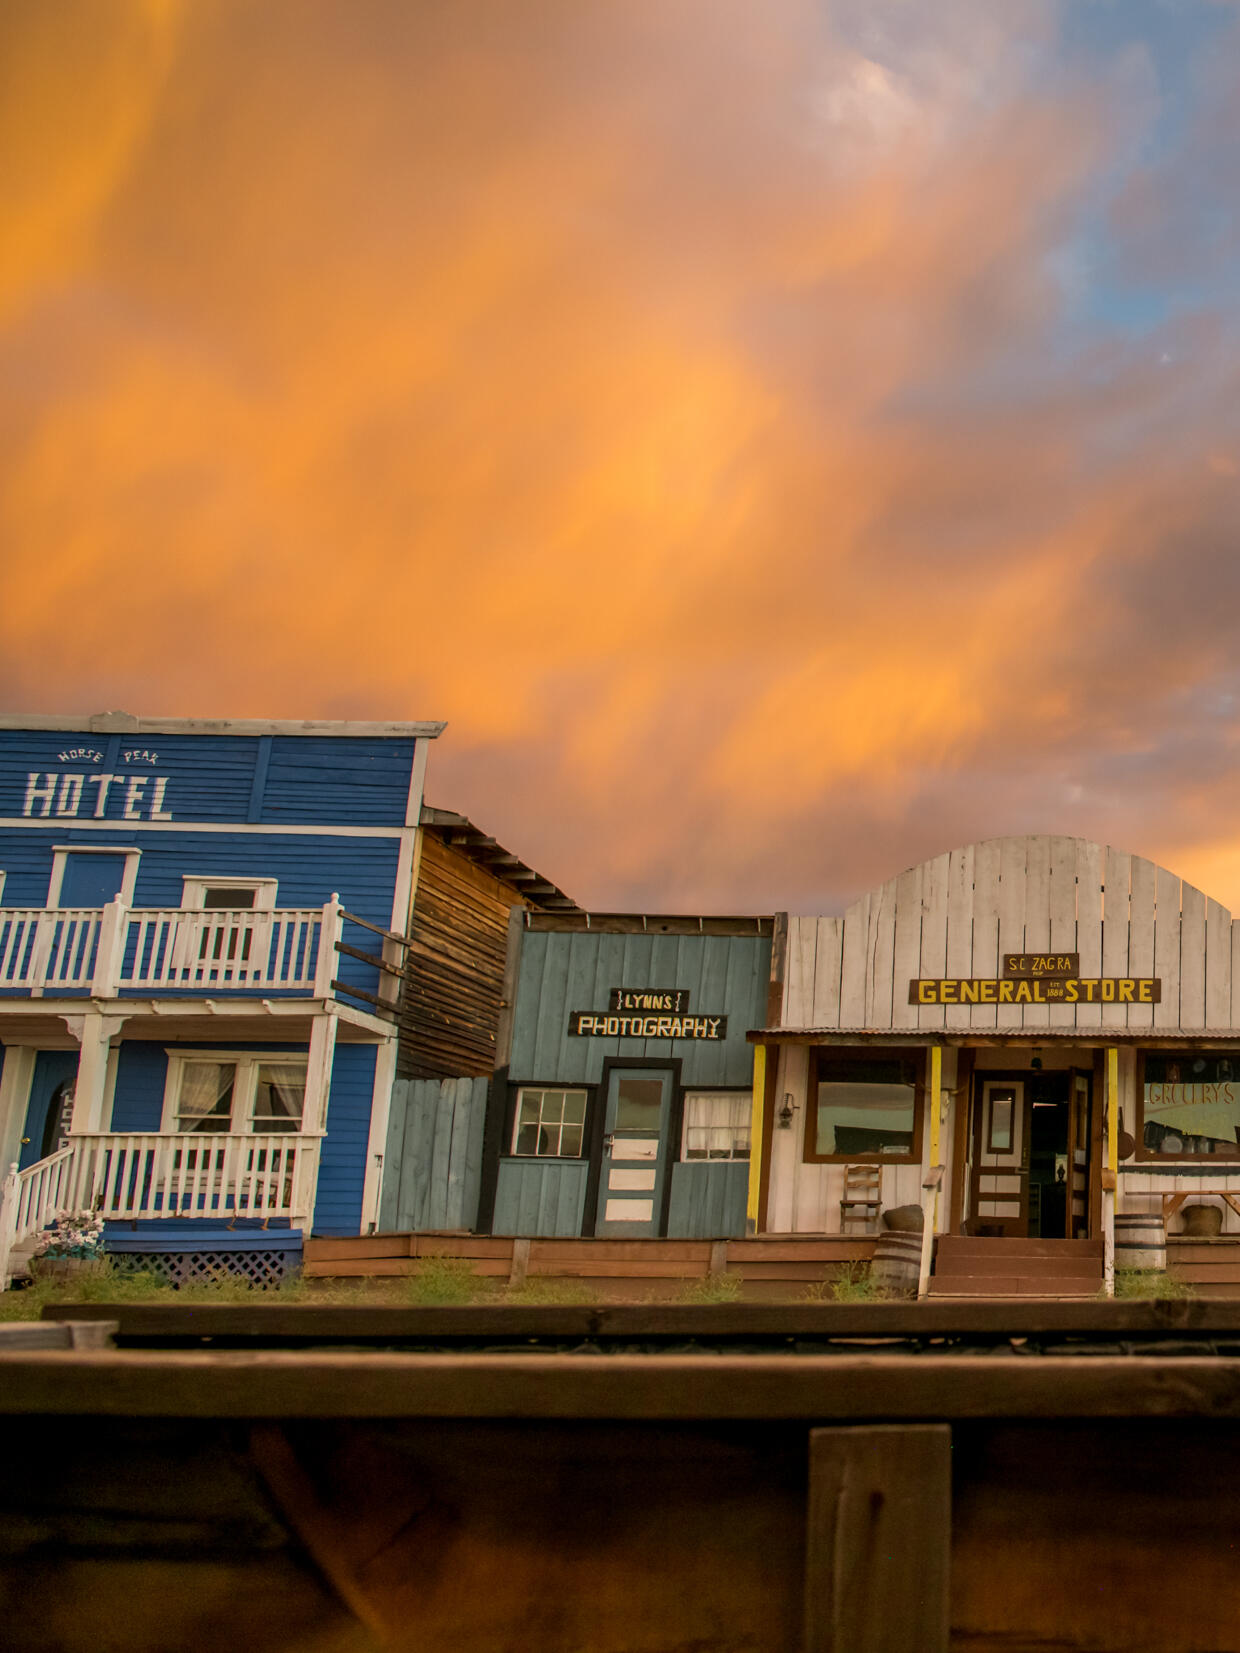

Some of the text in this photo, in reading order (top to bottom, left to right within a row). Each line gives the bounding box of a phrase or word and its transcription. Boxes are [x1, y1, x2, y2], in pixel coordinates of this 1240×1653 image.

[57, 748, 159, 765] HORSE PEAK
[22, 772, 173, 820] HOTEL
[1031, 957, 1071, 971] ZAGRA
[918, 980, 1046, 1003] GENERAL
[1064, 980, 1154, 1003] STORE
[577, 1015, 721, 1039] PHOTOGRAPHY
